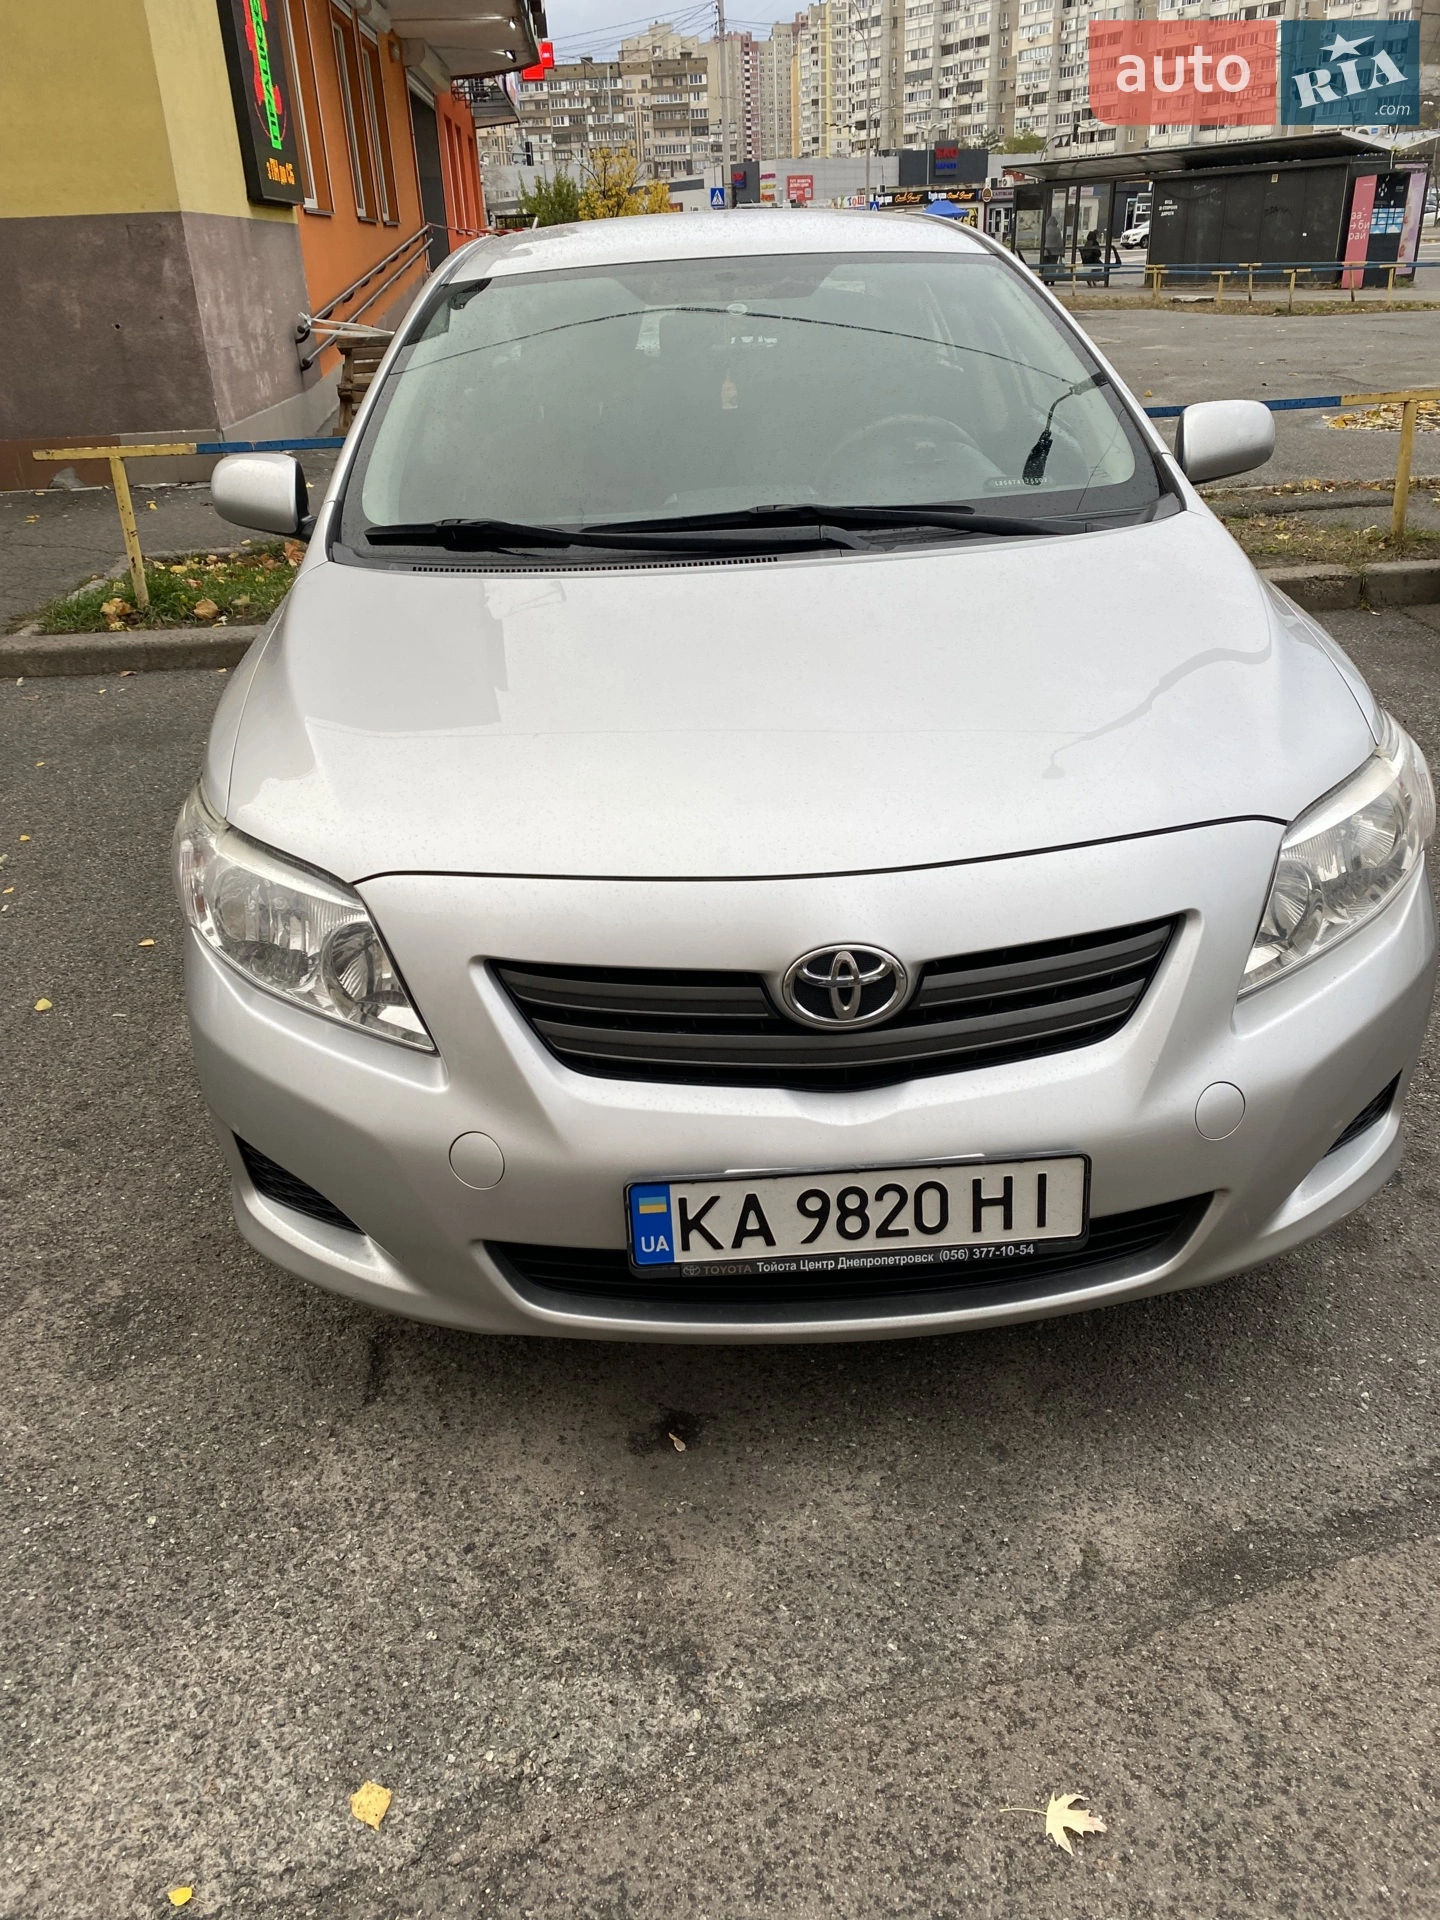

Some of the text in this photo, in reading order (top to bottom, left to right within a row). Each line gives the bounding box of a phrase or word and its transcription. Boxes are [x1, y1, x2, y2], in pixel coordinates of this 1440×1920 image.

[677, 1172, 1047, 1252] KA 9820 HI
[641, 1236, 670, 1253] UA
[703, 1264, 752, 1275] TOYOTA
[757, 1243, 1035, 1273] Тойота Центр Днепропетровск (056) 377-10-54
